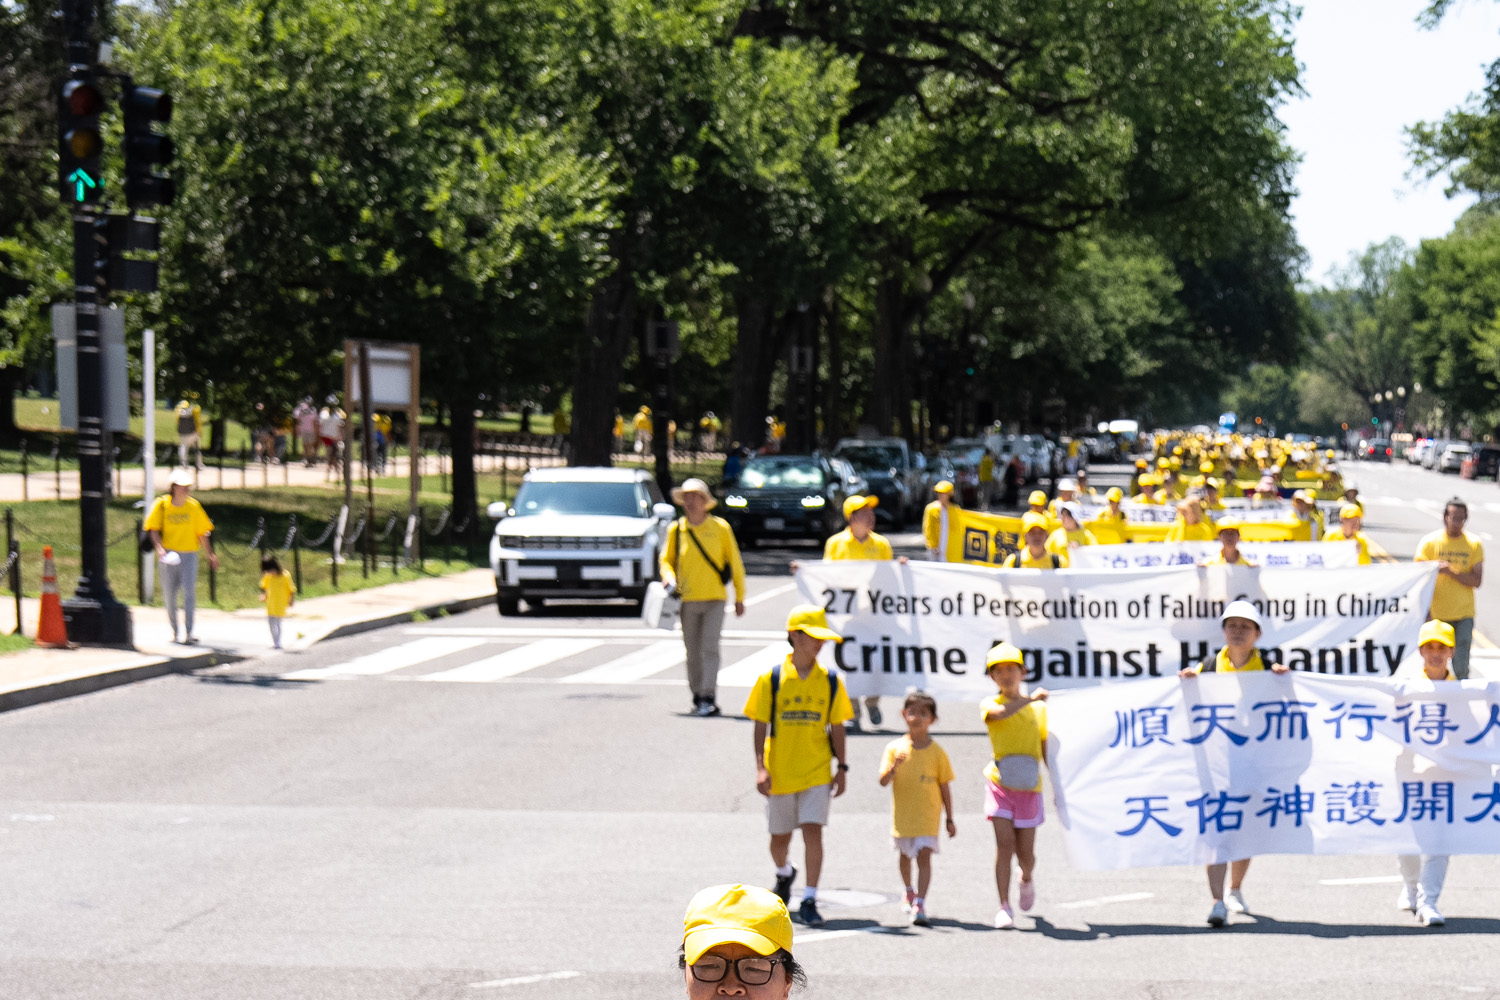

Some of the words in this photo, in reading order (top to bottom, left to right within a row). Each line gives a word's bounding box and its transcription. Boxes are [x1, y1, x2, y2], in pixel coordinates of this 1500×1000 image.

[822, 588, 856, 614] 27
[867, 589, 931, 616] Years
[941, 592, 963, 616] of
[973, 593, 1117, 619] Persecution
[1128, 594, 1151, 618] of
[1161, 593, 1224, 618] Falun
[1235, 594, 1295, 621] ong
[1306, 593, 1326, 618] in
[1336, 593, 1408, 616] China:
[834, 636, 967, 675] Crime
[984, 639, 1162, 683] gainst
